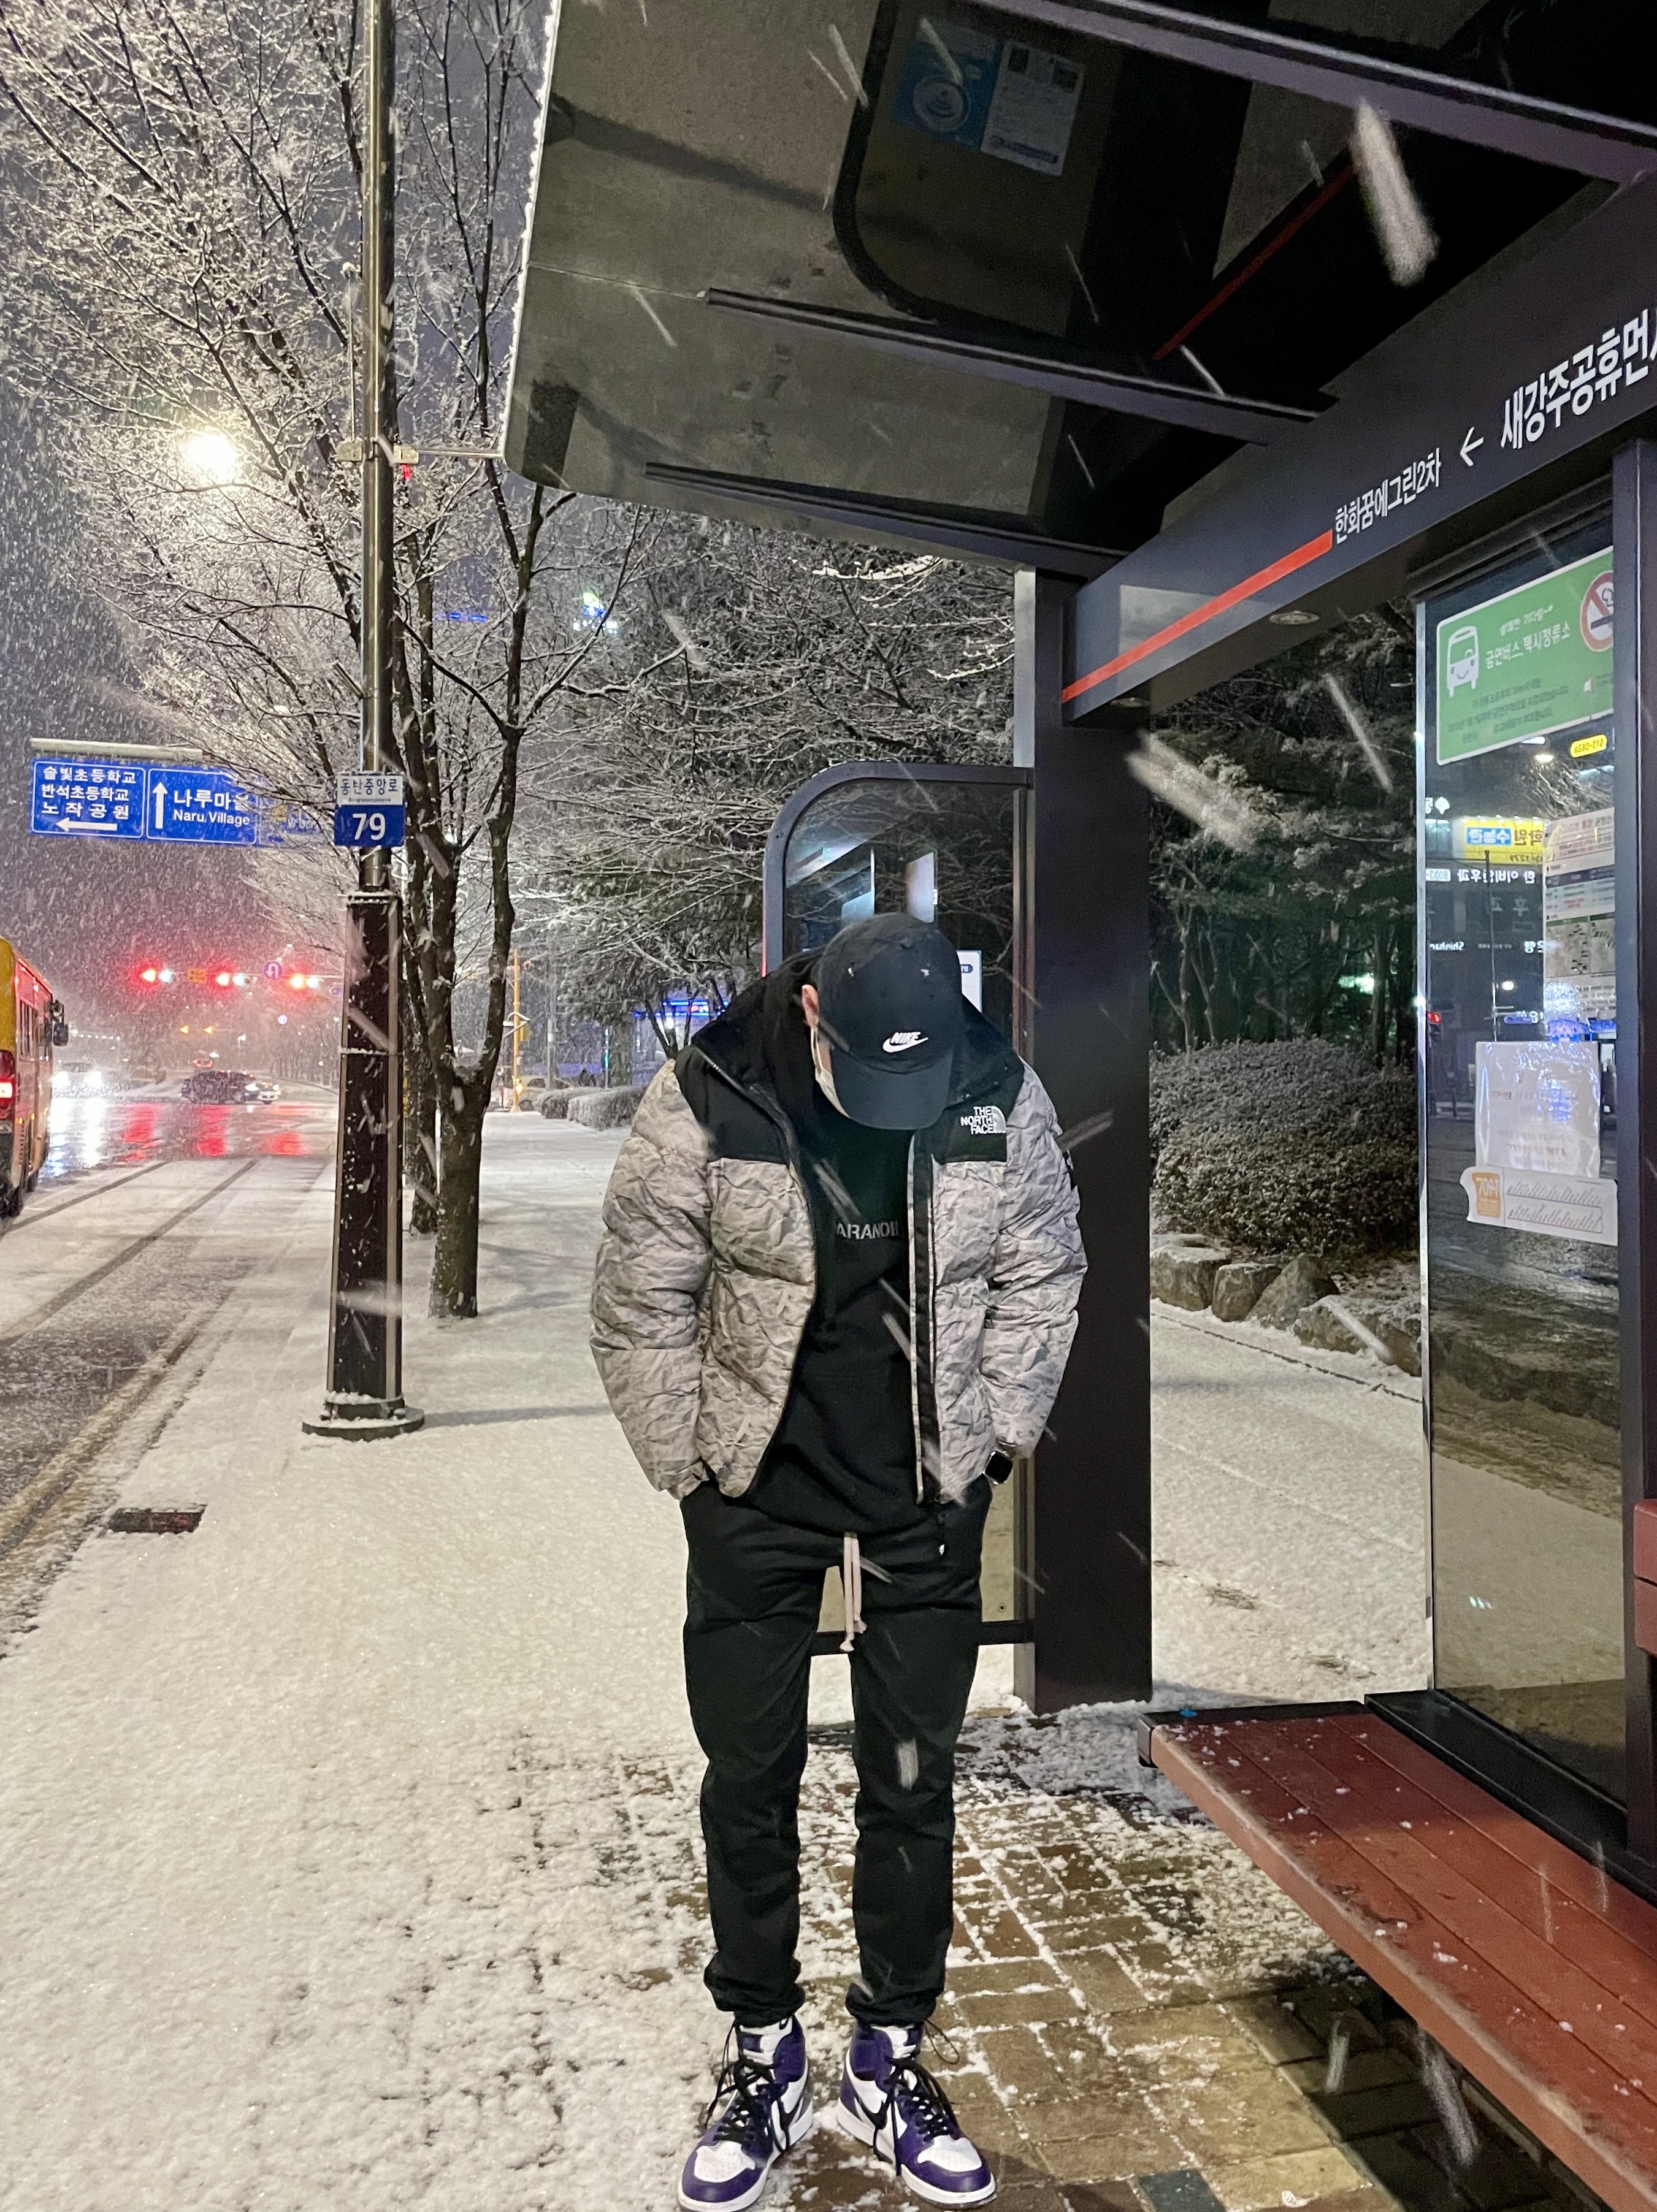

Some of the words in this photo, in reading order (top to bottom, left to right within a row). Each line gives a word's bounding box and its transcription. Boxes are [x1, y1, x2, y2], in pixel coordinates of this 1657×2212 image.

[1500, 308, 1657, 449] 새강주공휴먼
[1334, 448, 1441, 544] 한화꿈에그린2차
[43, 766, 136, 784] 솔빛초등학교
[42, 784, 129, 802] 반석초등학교
[173, 809, 204, 823] Naru
[209, 811, 250, 828] Village
[352, 812, 386, 841] 79
[890, 1031, 921, 1044] NIKE
[973, 1106, 992, 1116] THE
[960, 1115, 992, 1126] NORTH
[970, 1124, 994, 1135] FACE
